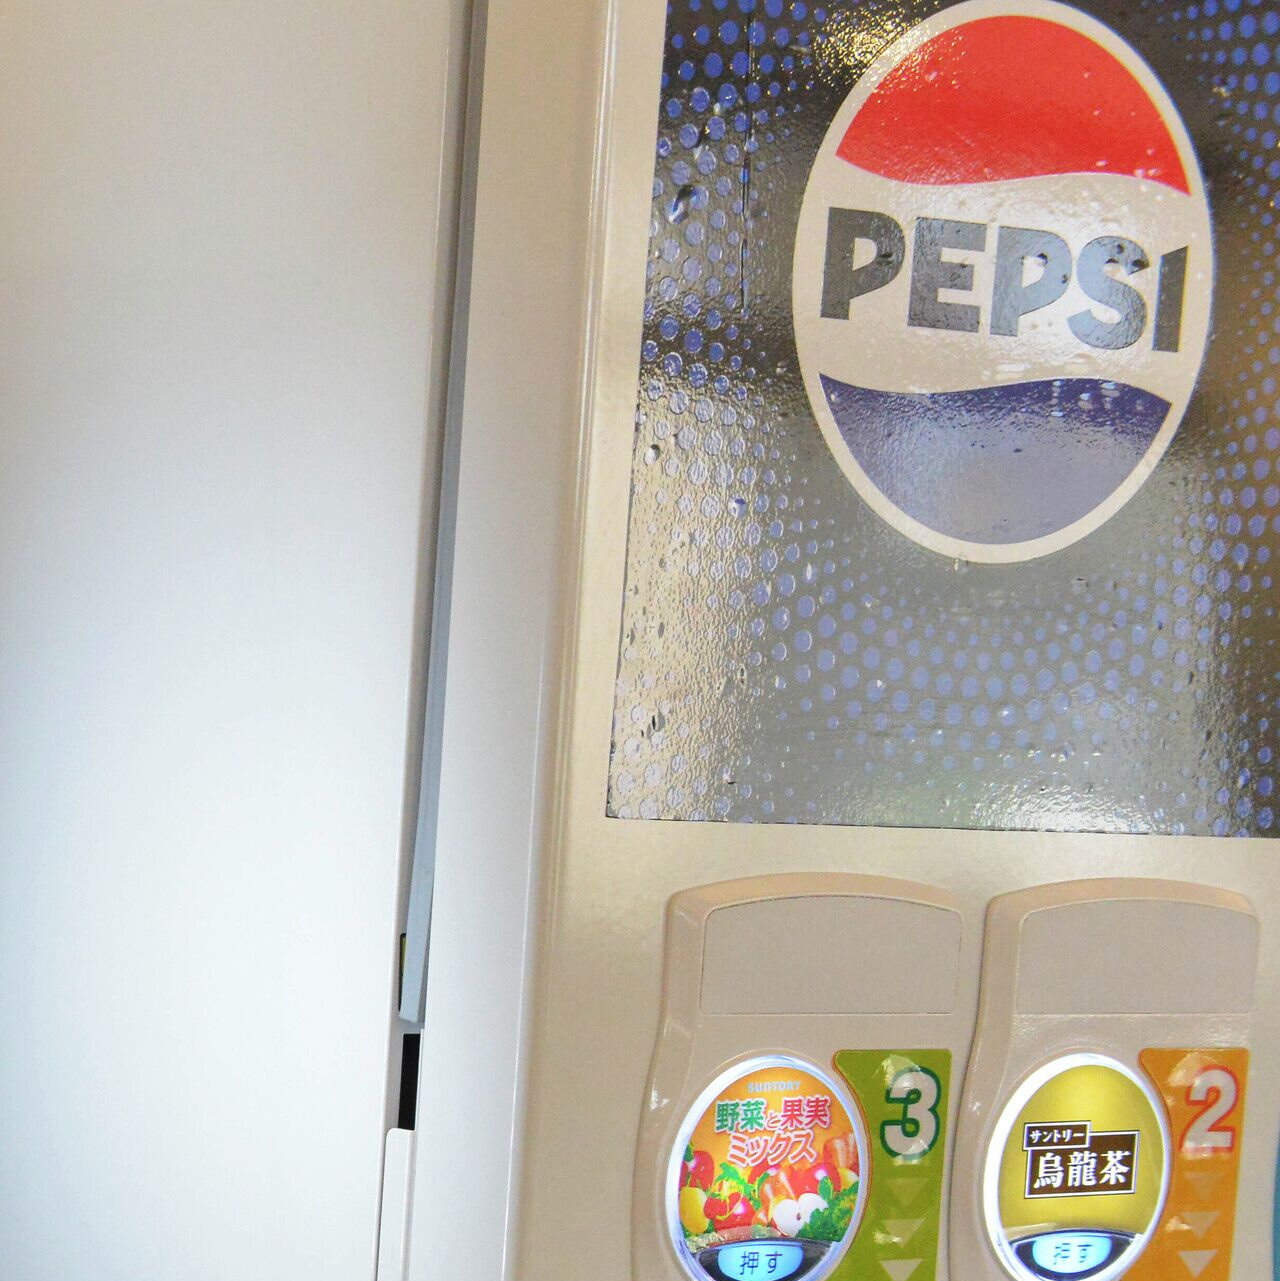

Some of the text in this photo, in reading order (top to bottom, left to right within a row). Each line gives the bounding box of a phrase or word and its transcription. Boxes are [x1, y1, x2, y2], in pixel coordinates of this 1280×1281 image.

[819, 206, 1190, 354] PEPSI
[715, 1095, 831, 1133] 野菜と果実
[879, 1065, 941, 1161] 3
[1179, 1064, 1240, 1154] 2
[727, 1128, 817, 1167] ミックス
[1029, 1128, 1085, 1143] サントリー
[1033, 1150, 1132, 1189] 烏龍茶
[739, 1250, 783, 1275] 押す
